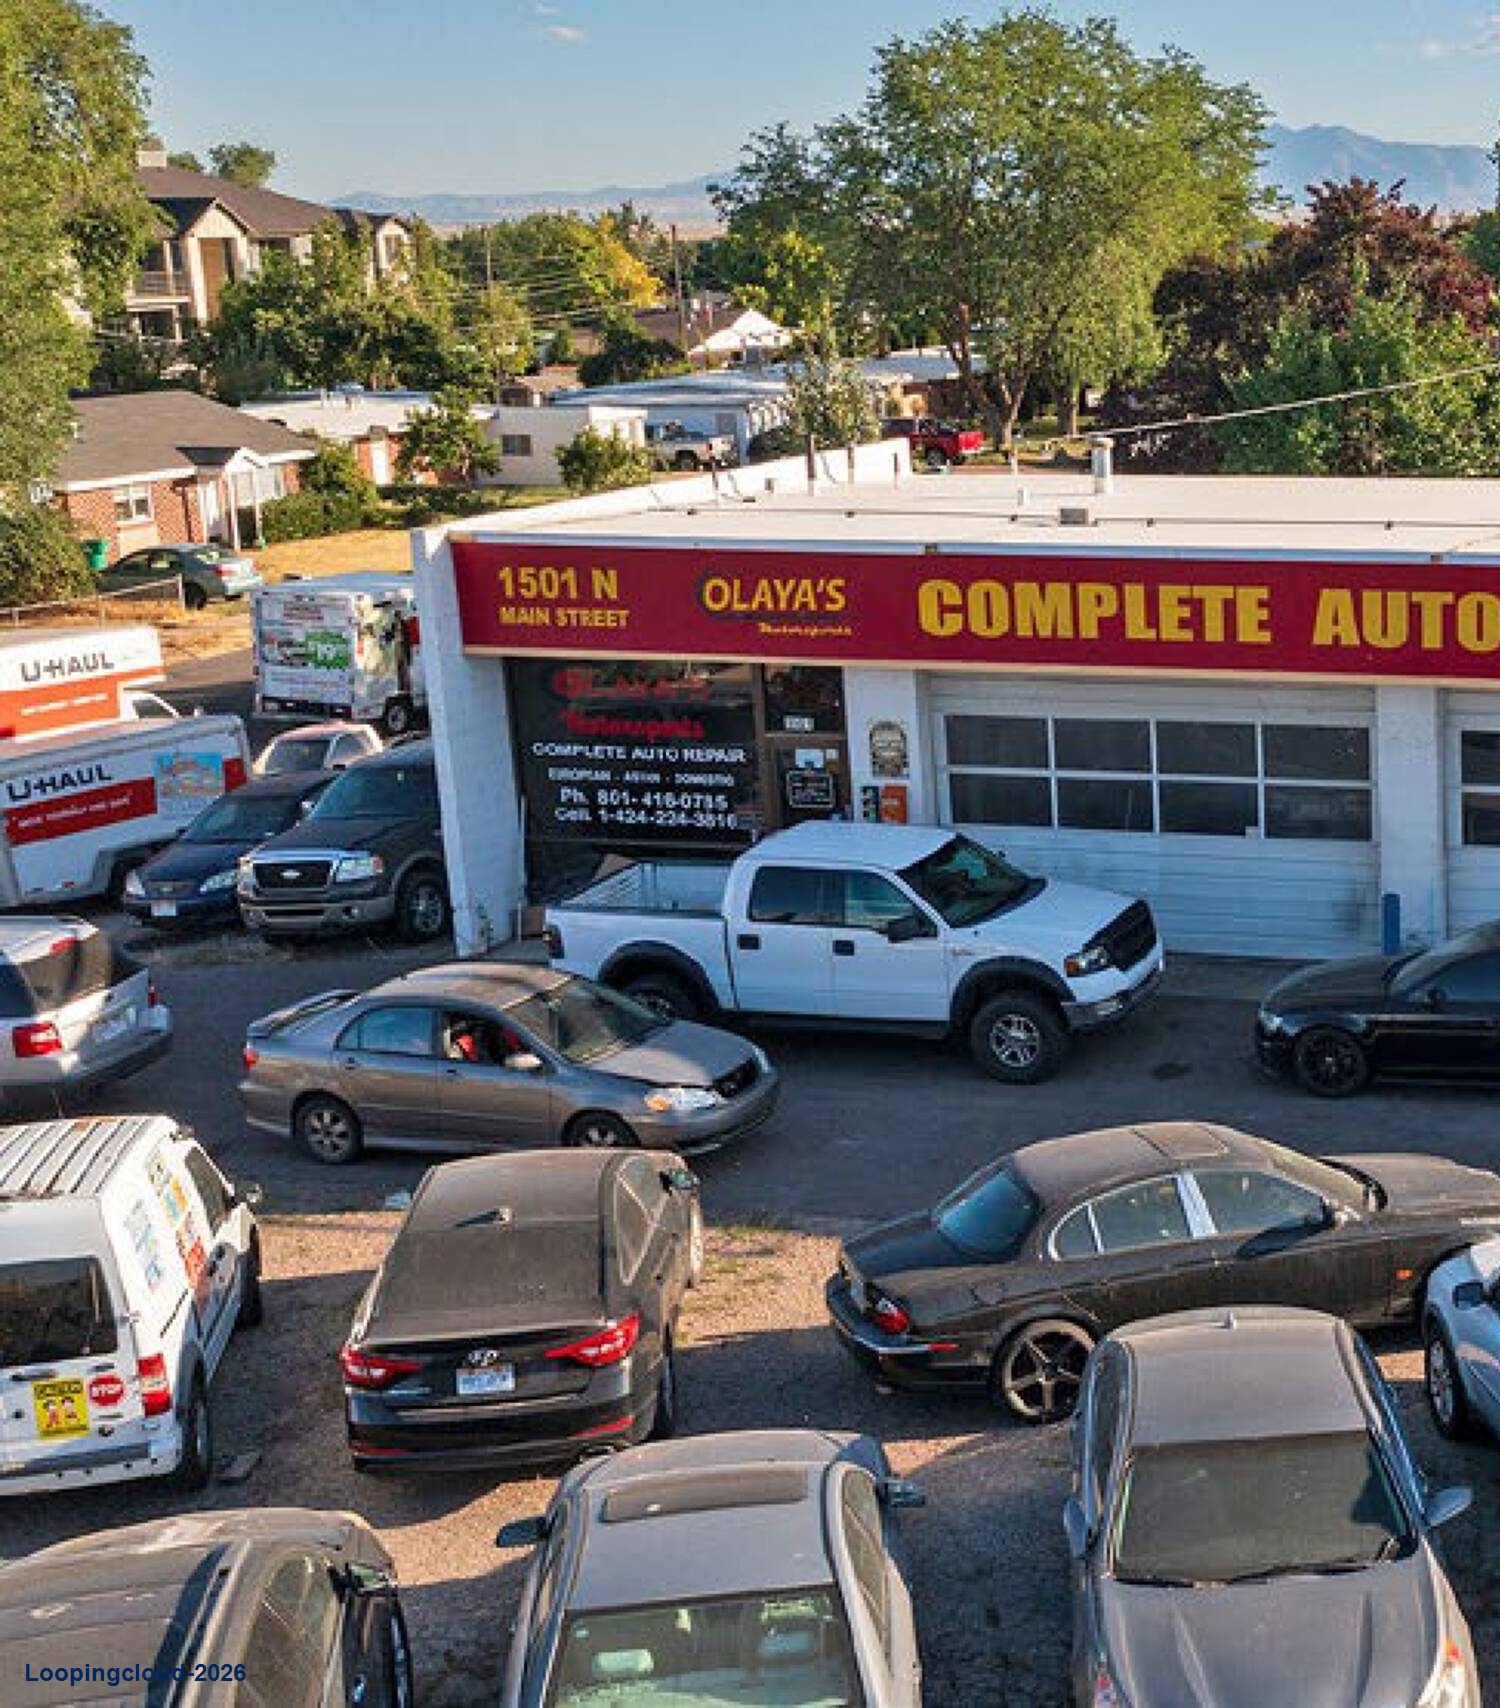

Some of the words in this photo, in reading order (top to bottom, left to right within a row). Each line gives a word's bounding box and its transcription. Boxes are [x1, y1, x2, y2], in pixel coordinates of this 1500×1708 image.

[499, 566, 578, 600] 1501
[591, 568, 618, 600] N
[702, 577, 846, 612] OLAYA'S
[500, 606, 550, 627] MAIN
[555, 608, 630, 629] STREET
[918, 578, 1271, 643] COMPLETE
[532, 742, 627, 760] COMPLETE
[631, 747, 679, 762] AUTO
[683, 748, 747, 763] REPAIR
[6, 764, 112, 801] U-HAUL
